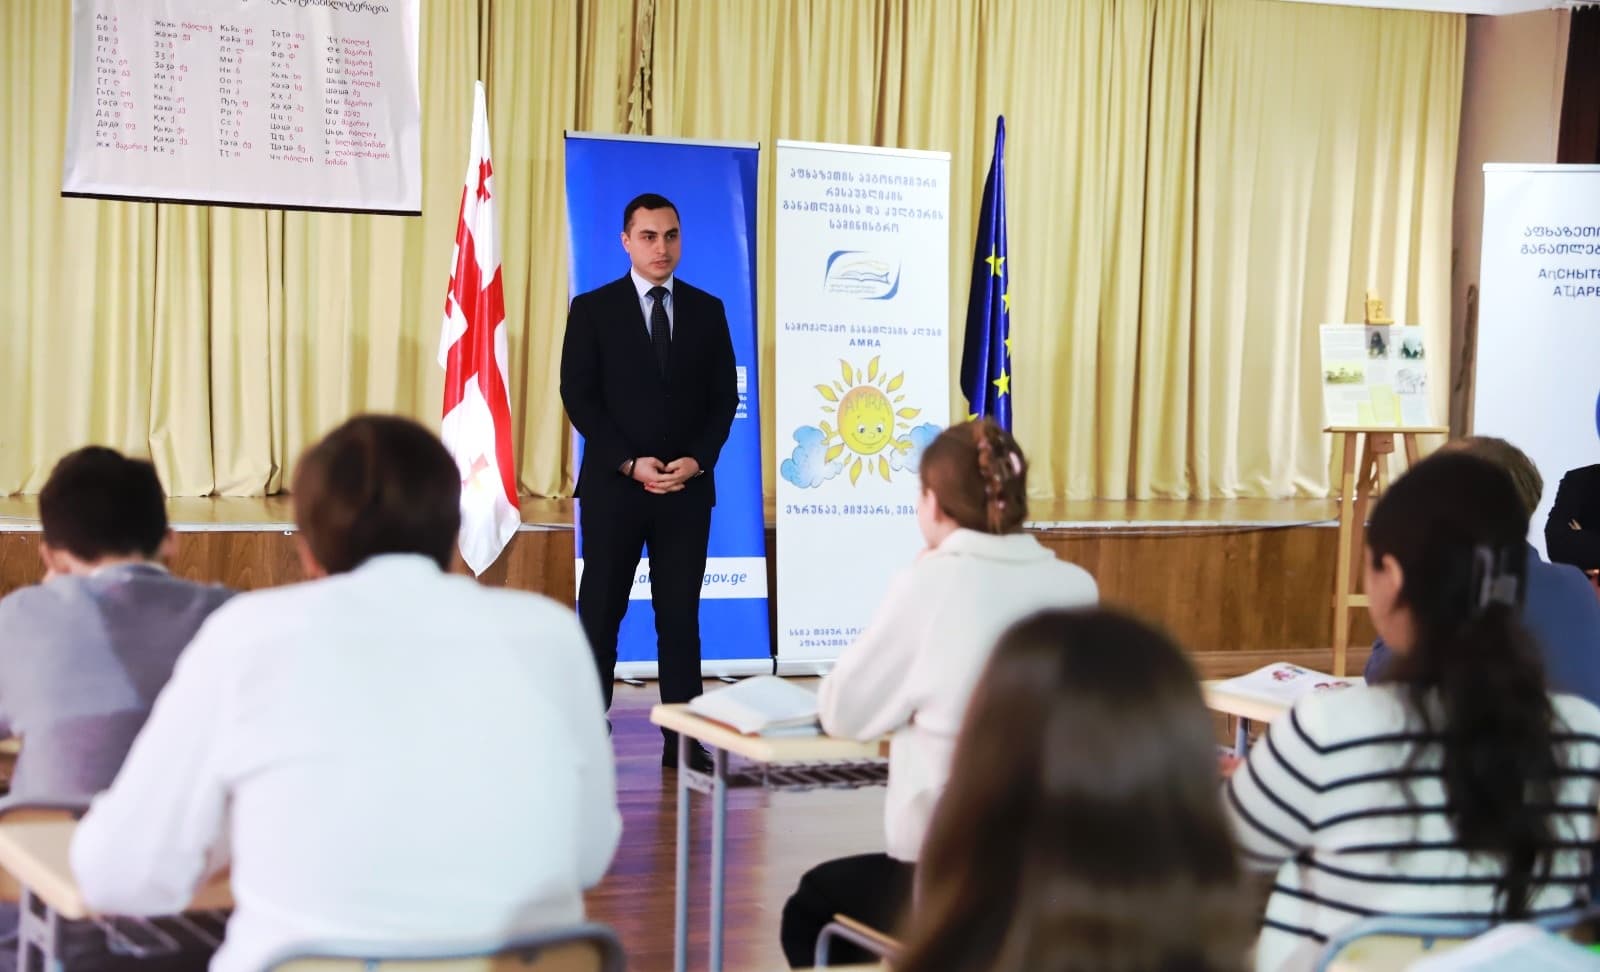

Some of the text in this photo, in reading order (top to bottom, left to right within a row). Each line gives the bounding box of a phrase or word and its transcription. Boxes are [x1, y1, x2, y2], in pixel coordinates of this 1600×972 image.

[790, 168, 854, 182] აფხაზეთის
[784, 200, 861, 215] განათლებისა
[866, 206, 880, 215] და
[830, 219, 899, 233] სამინისტრო
[849, 339, 881, 347] AMRA
